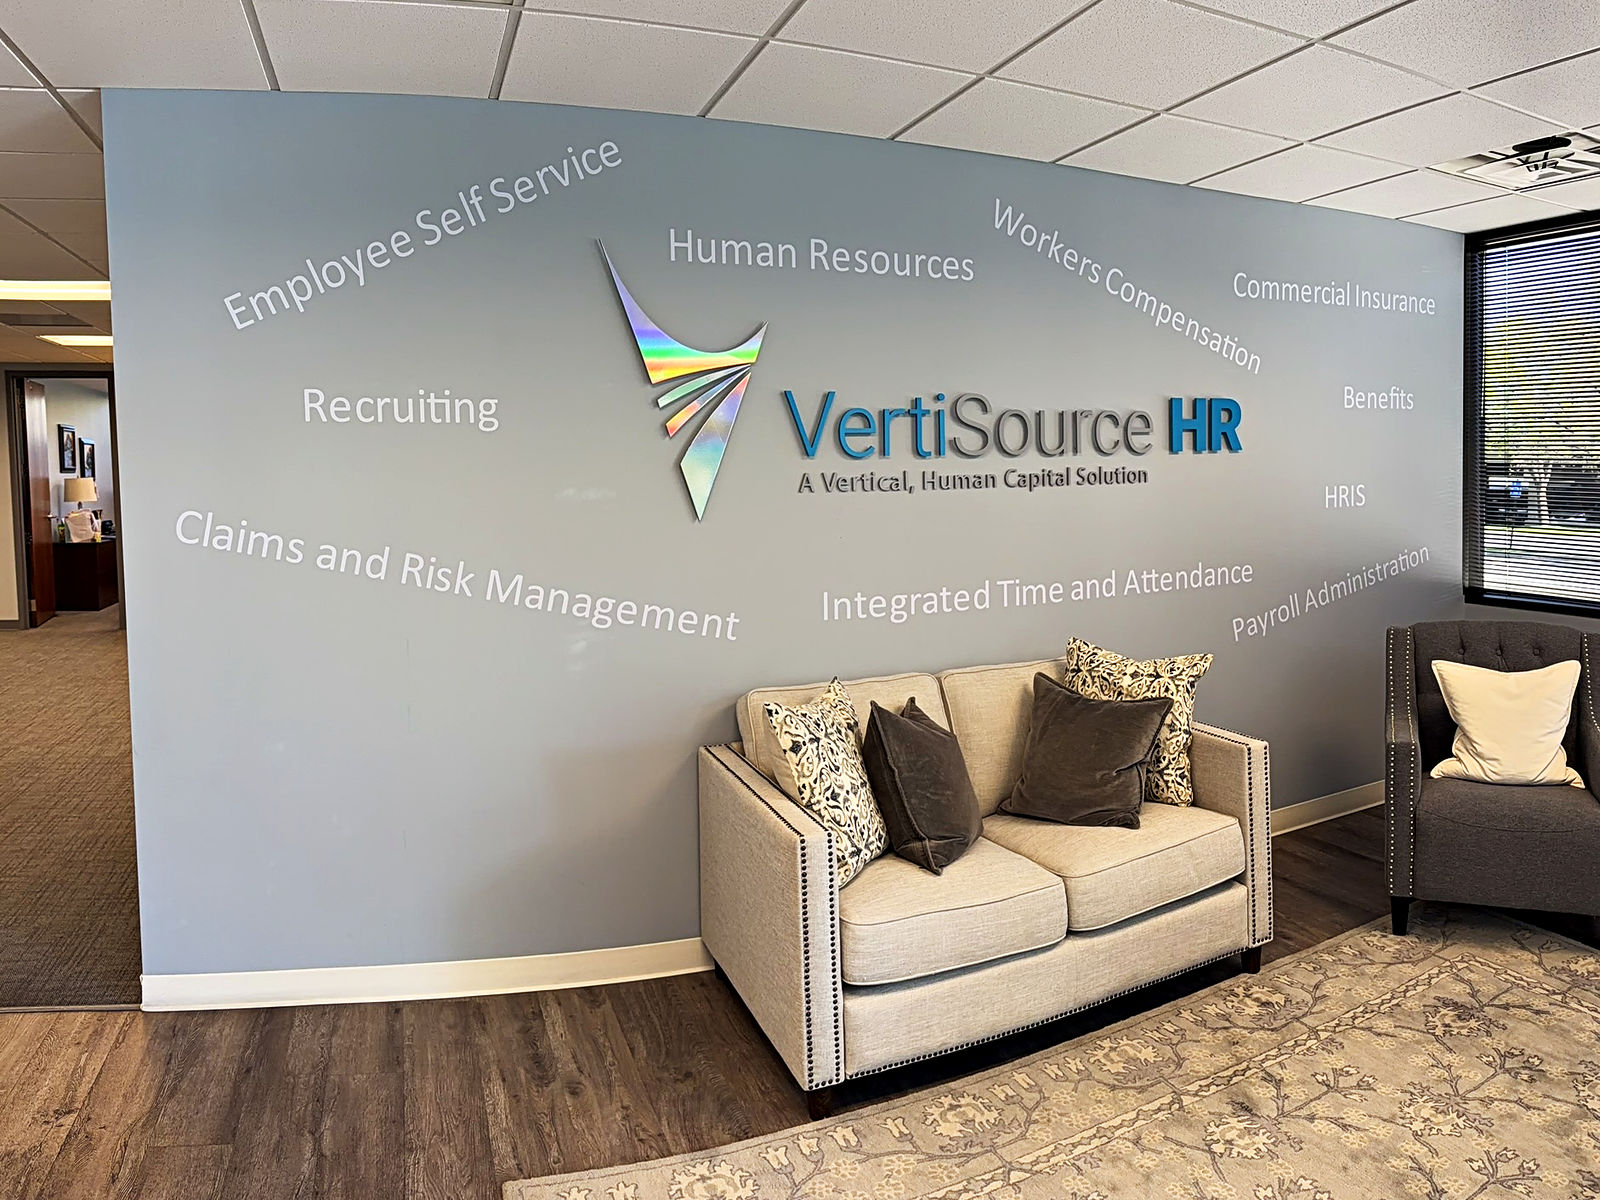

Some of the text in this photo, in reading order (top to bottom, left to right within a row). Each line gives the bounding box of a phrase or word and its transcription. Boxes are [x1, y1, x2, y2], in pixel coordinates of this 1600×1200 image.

[224, 141, 623, 330] Employee Self Service
[669, 228, 975, 282] Human Resources
[993, 198, 1262, 375] Workers Compensation
[1233, 272, 1436, 315] Commercial Insurance
[303, 388, 499, 432] Recruiting
[783, 389, 1243, 458] VertiSource HR
[1343, 385, 1415, 410] Benefits
[799, 466, 1148, 493] A Vertical, Human Capital Solution
[1325, 484, 1366, 508] HRIS
[175, 510, 740, 642] Claims and Risk Management
[823, 564, 1254, 624] Integrated Time and Attendance
[1232, 546, 1431, 643] Payroll Administration
